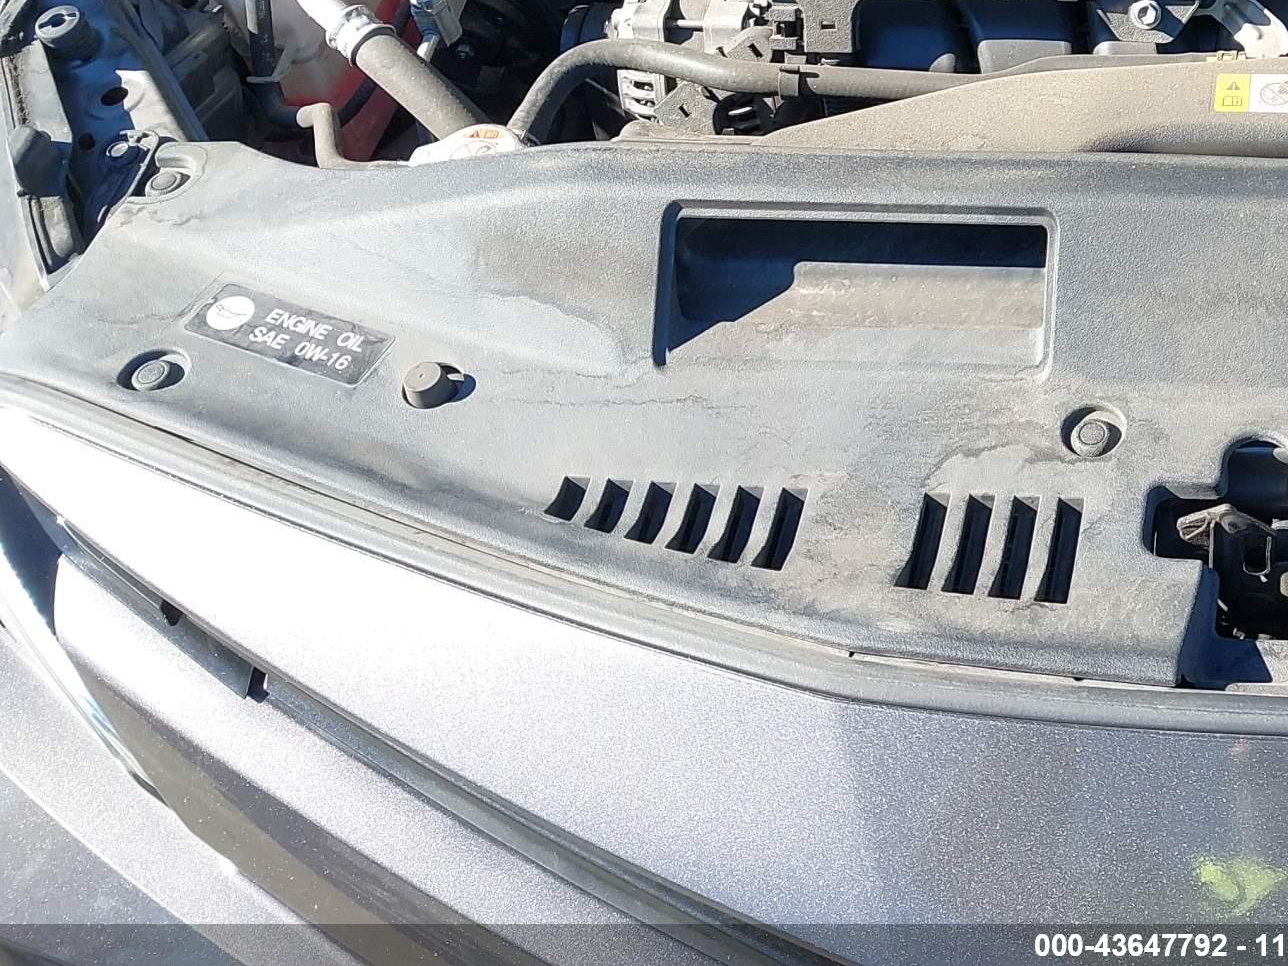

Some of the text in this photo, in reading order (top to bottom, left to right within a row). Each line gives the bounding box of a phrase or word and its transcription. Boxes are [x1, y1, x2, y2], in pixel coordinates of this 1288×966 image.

[249, 326, 352, 370] SAE 0W-16
[265, 308, 364, 352] ENGINE OIL
